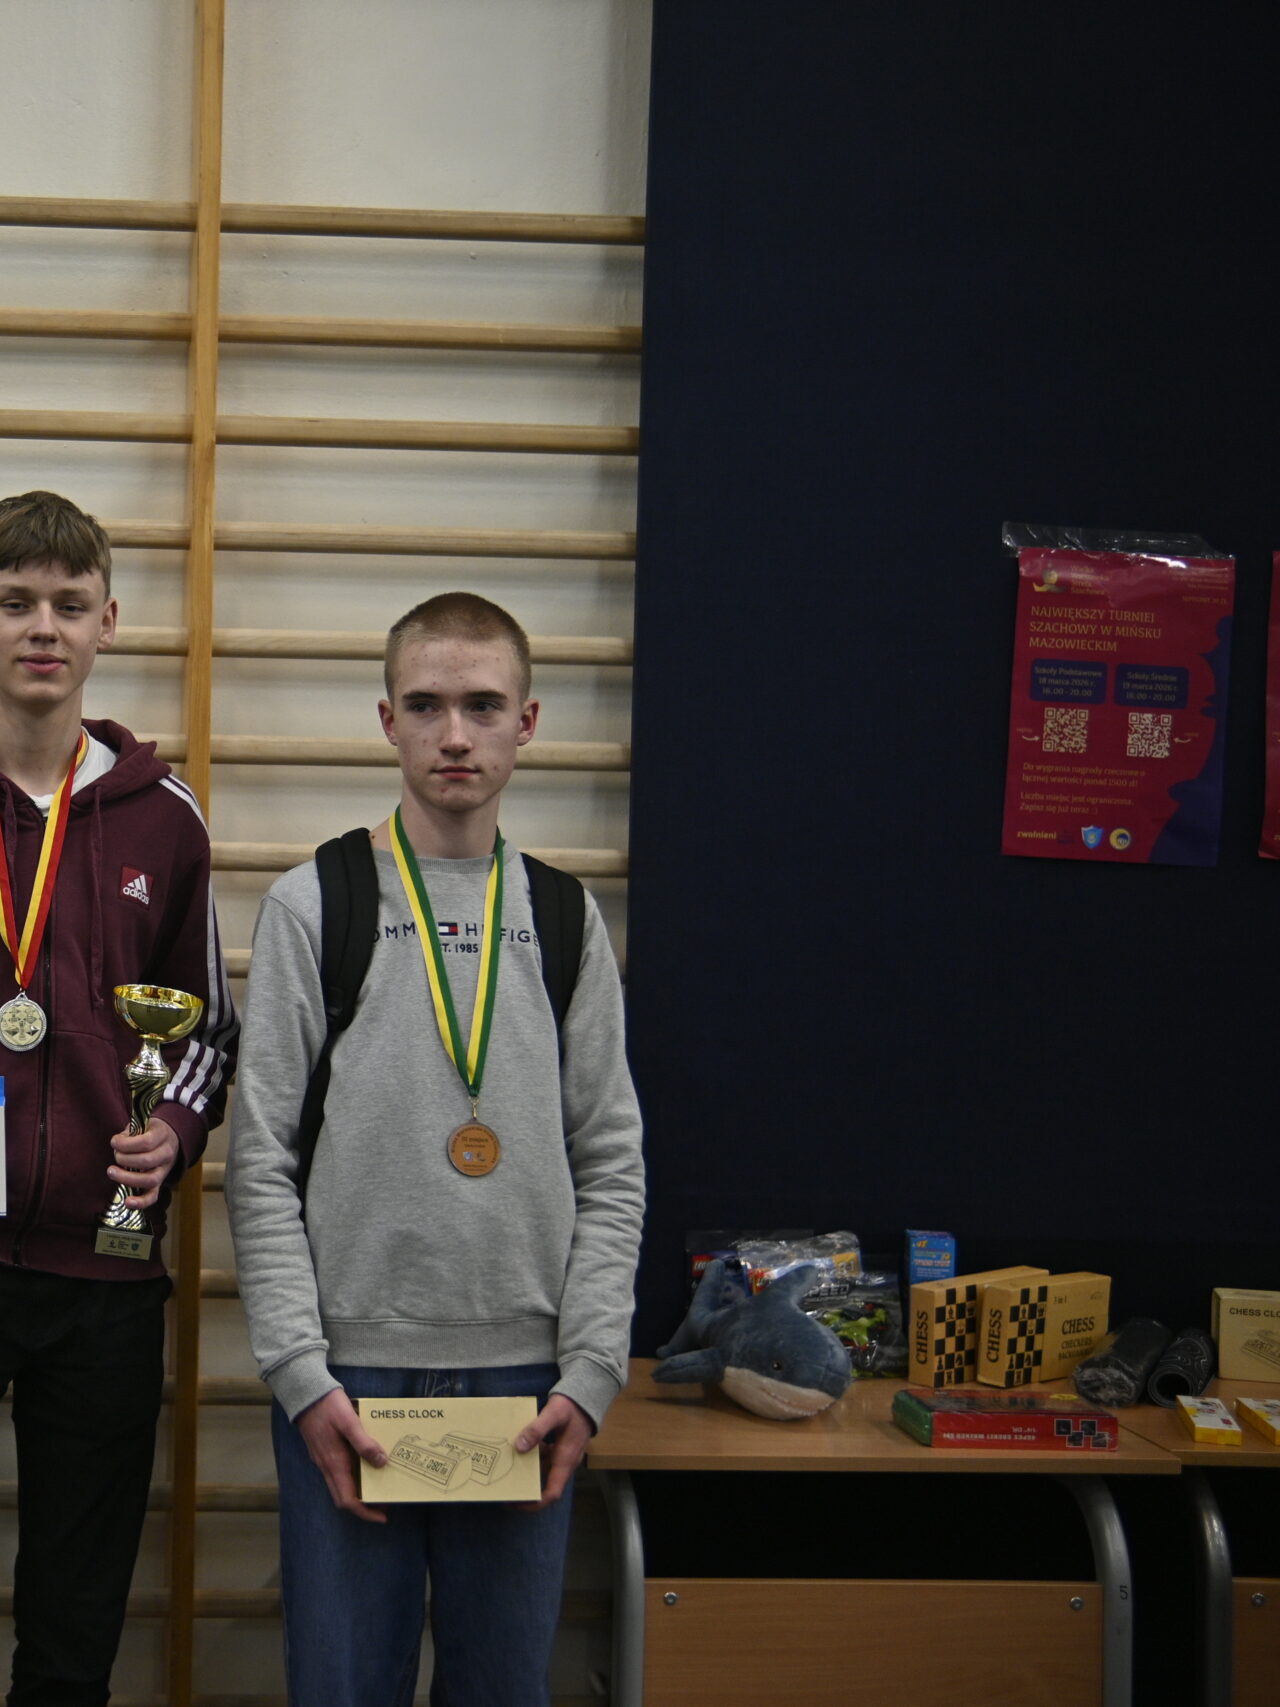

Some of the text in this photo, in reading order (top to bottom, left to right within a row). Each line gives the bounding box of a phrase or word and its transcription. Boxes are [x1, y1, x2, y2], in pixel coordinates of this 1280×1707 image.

[1031, 606, 1155, 624] NAJWIĘKSZY TURNIEJ
[1029, 621, 1161, 640] SZACHOWY W MIŃSKU
[1029, 637, 1118, 652] MAZOWIECKIM
[122, 886, 150, 905] adidas
[455, 944, 478, 953] 1985
[1229, 1307, 1261, 1318] CHESS
[1061, 1316, 1095, 1335] CHESS
[915, 1310, 928, 1365] CHESS
[986, 1308, 1002, 1363] CHESS
[370, 1409, 444, 1419] CHESS CLOCK
[1120, 1584, 1128, 1600] 5
